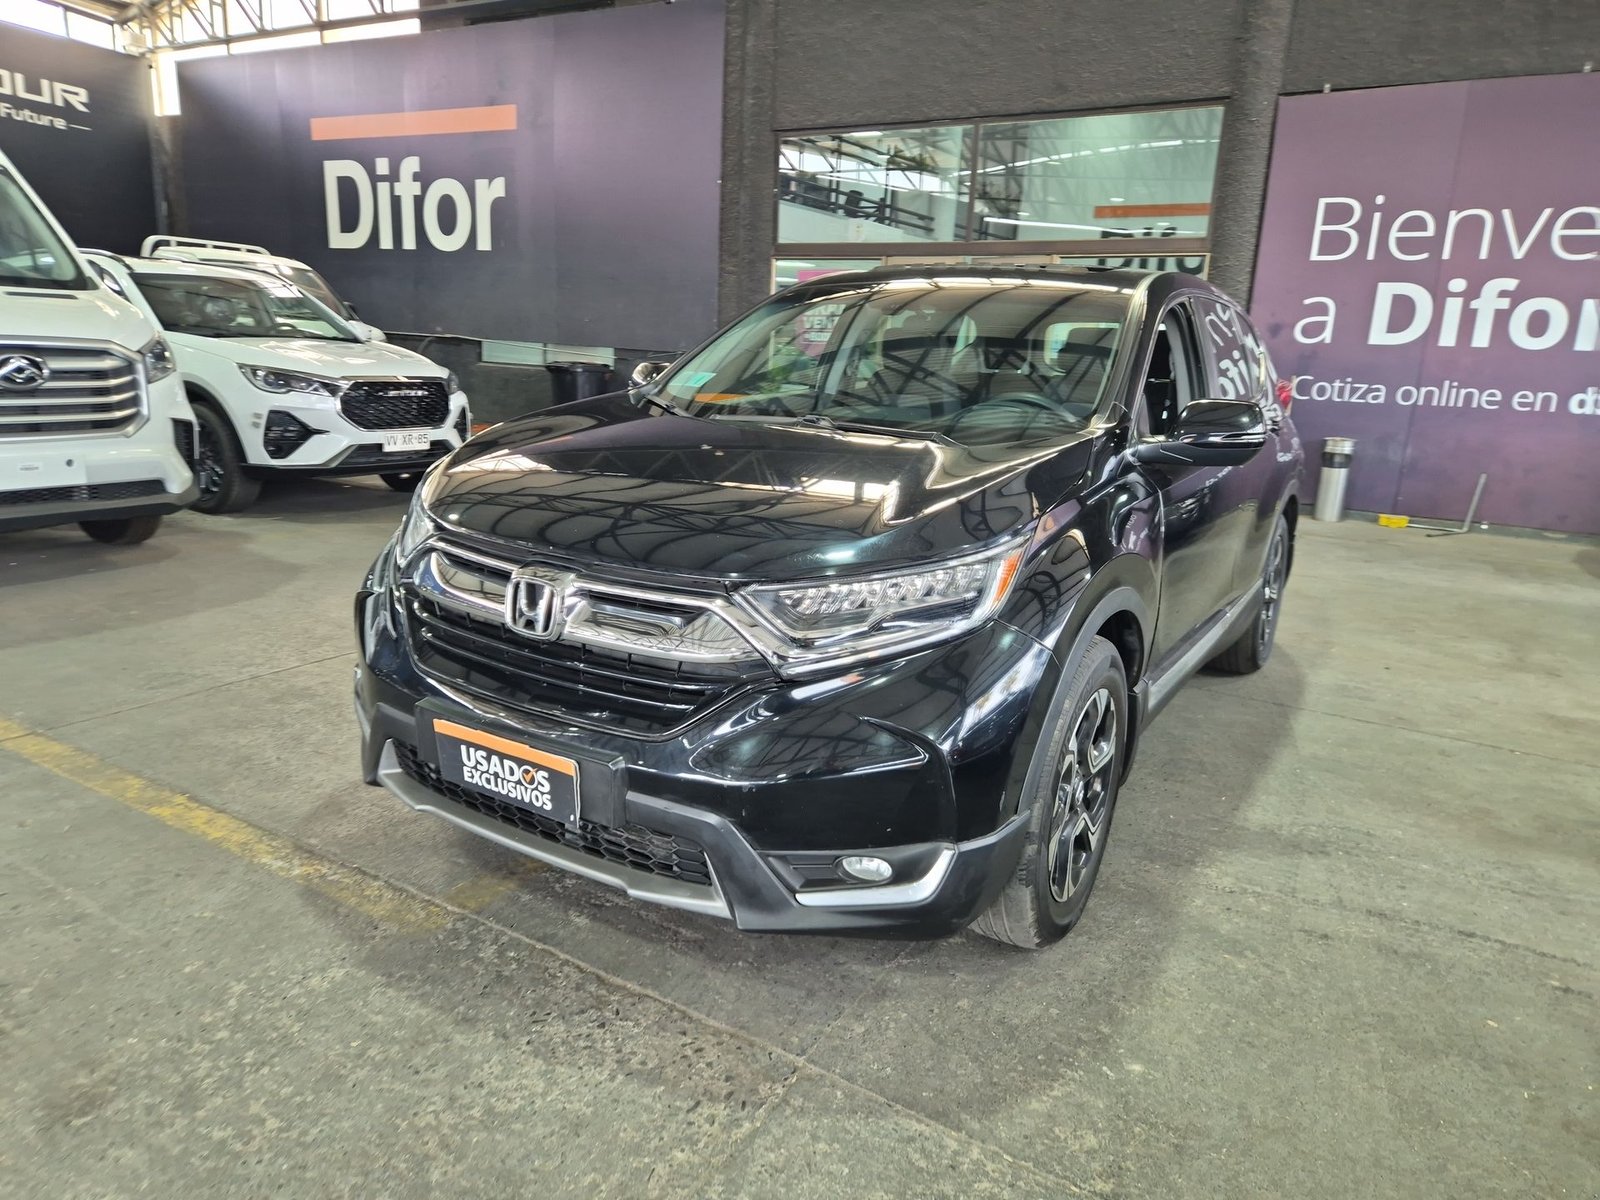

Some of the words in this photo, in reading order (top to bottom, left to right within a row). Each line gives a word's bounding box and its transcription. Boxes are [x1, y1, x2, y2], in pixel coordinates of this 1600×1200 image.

[322, 156, 506, 252] Difor
[1309, 194, 1600, 262] Bienve
[1293, 296, 1336, 344] a
[1292, 375, 1386, 404] Cotiza
[1395, 380, 1502, 410] online
[1511, 390, 1558, 412] en
[460, 744, 551, 793] USADOS
[462, 766, 553, 811] EXCLUSIVOS
